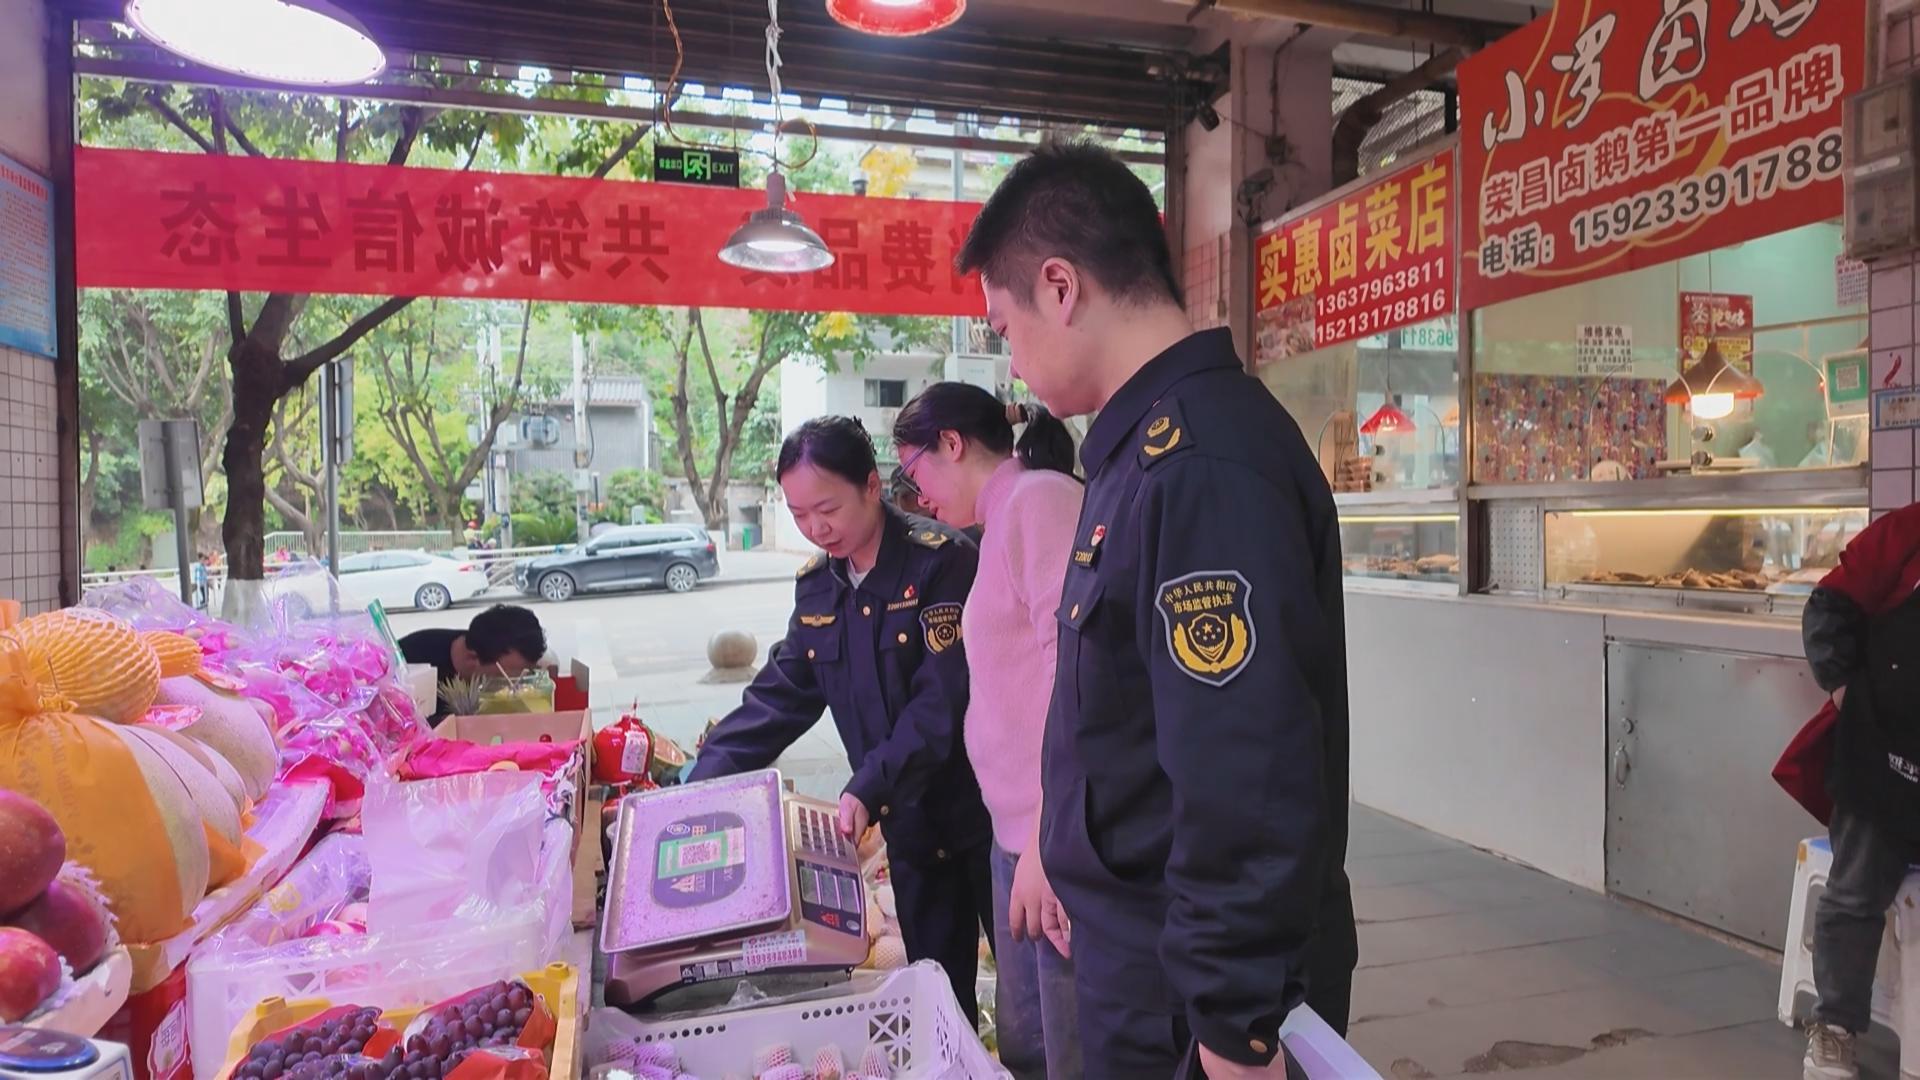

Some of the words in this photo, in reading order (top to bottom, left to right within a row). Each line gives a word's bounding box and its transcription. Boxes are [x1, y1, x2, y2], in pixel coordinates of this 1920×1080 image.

[1484, 47, 1842, 222] 荣昌卤鹅第一品牌
[712, 161, 735, 175] EXIT
[1573, 132, 1843, 249] 15923391788
[1260, 163, 1447, 308] 实惠卤菜店
[1317, 257, 1444, 316] 13637963811
[1316, 288, 1445, 343] 15213178816
[1164, 579, 1237, 604] 中华人民共和国
[1173, 593, 1233, 614] 市场监管执法
